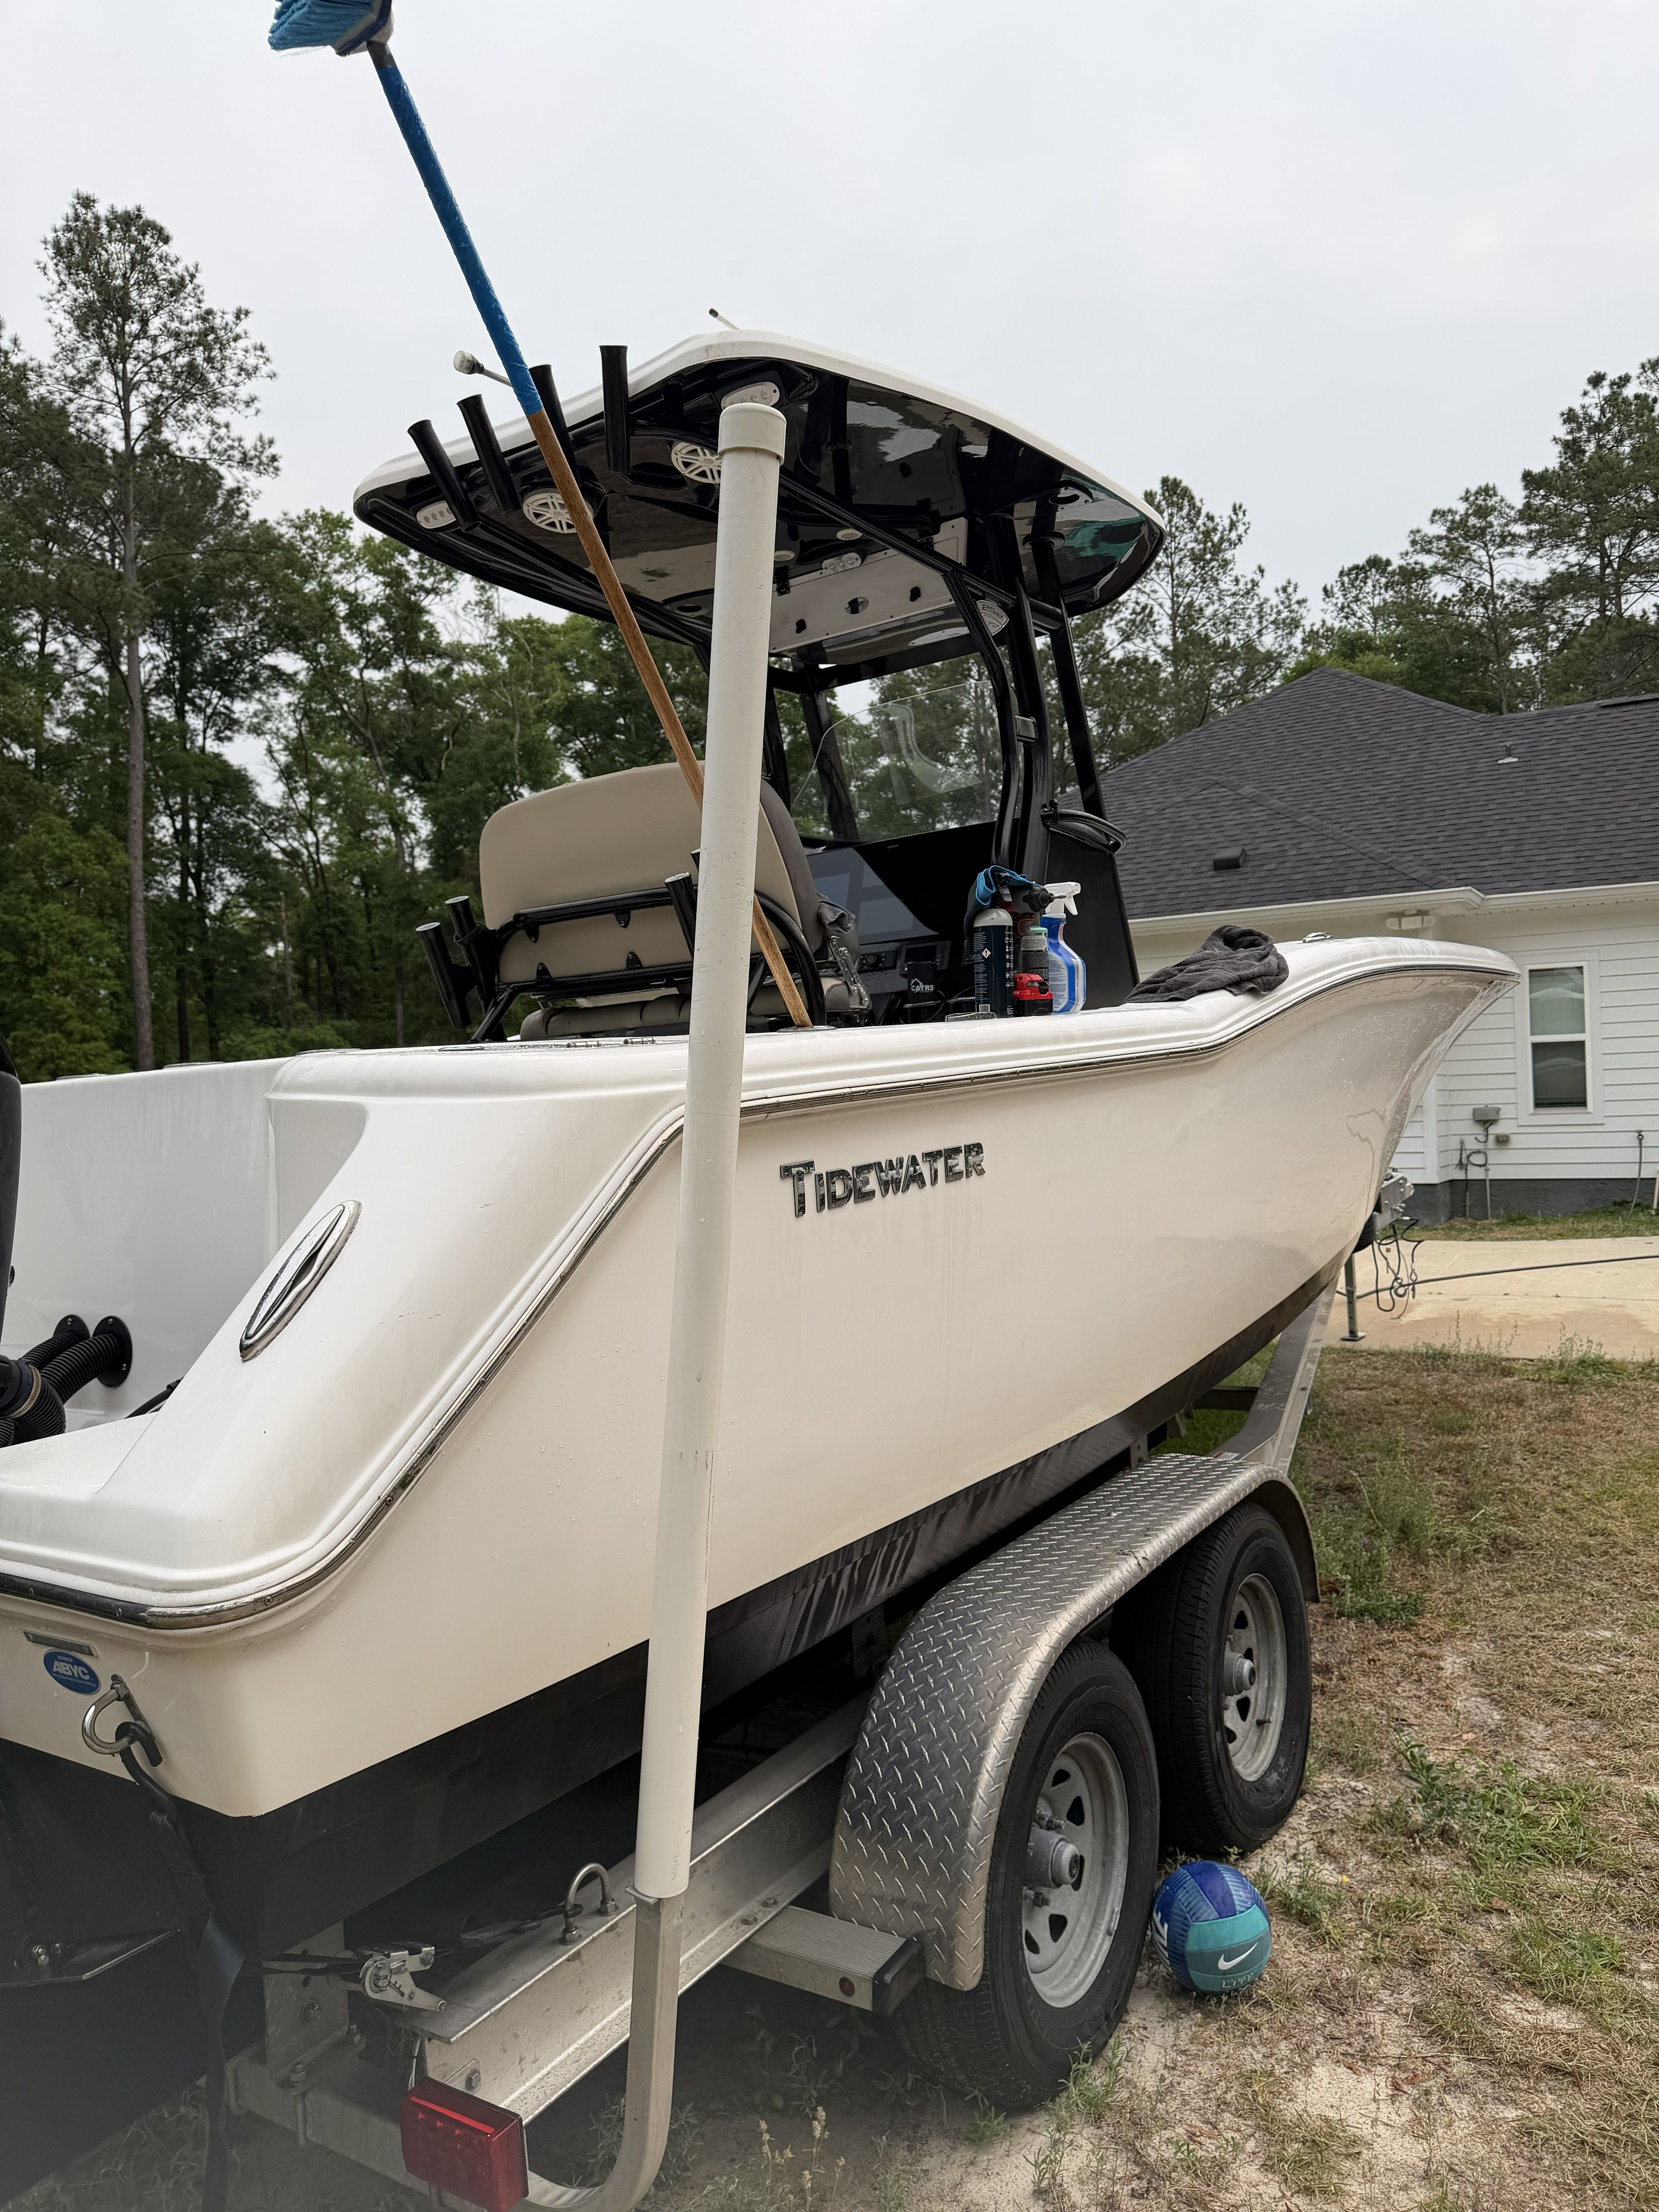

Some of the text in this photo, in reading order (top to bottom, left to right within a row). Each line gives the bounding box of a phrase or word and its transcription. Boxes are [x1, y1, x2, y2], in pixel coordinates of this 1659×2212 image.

[982, 605, 1004, 621] 252
[780, 1142, 986, 1218] TIDEWATER
[53, 1660, 90, 1680] ABYC
